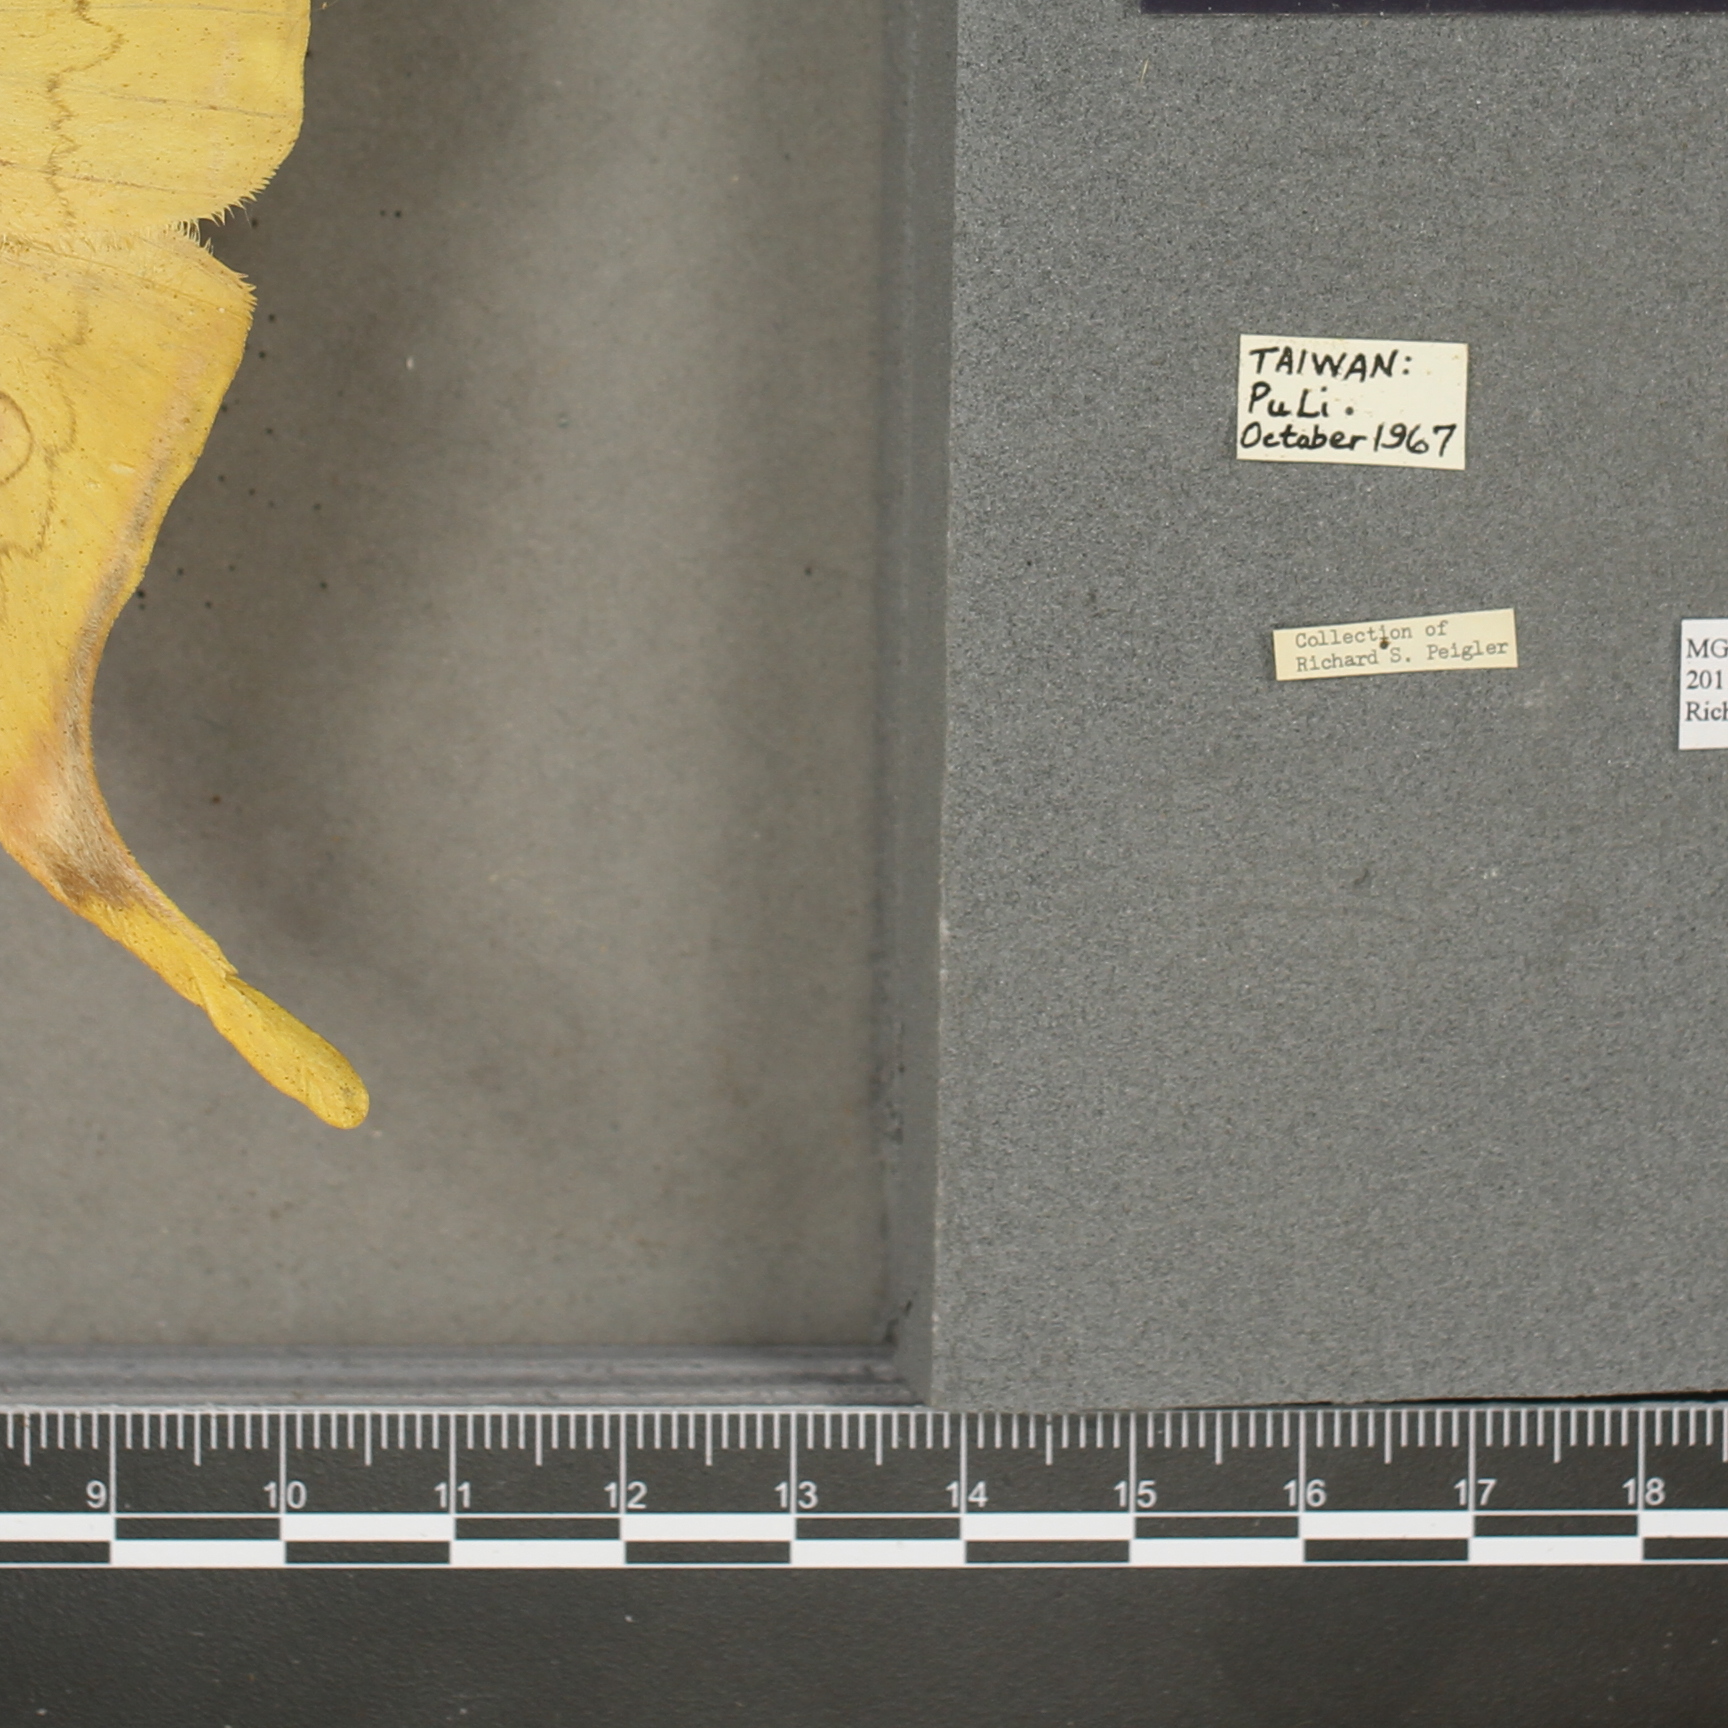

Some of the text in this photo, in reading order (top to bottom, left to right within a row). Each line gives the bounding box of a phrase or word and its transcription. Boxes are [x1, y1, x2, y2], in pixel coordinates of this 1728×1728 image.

[1248, 345, 1413, 383] TAIWAN:
[1240, 421, 1458, 458] October 1967
[1295, 619, 1449, 649] Collection of
[1296, 641, 1509, 672] Richard S. Peigler
[86, 1480, 107, 1509] 9
[264, 1481, 307, 1509] 10
[434, 1481, 472, 1509] 11
[604, 1481, 647, 1509] 12
[775, 1481, 818, 1509] 13
[945, 1481, 988, 1508] 14
[1114, 1480, 1157, 1508] 15
[1284, 1479, 1327, 1507] 16
[1454, 1479, 1496, 1506] 17
[1622, 1478, 1665, 1505] 18
